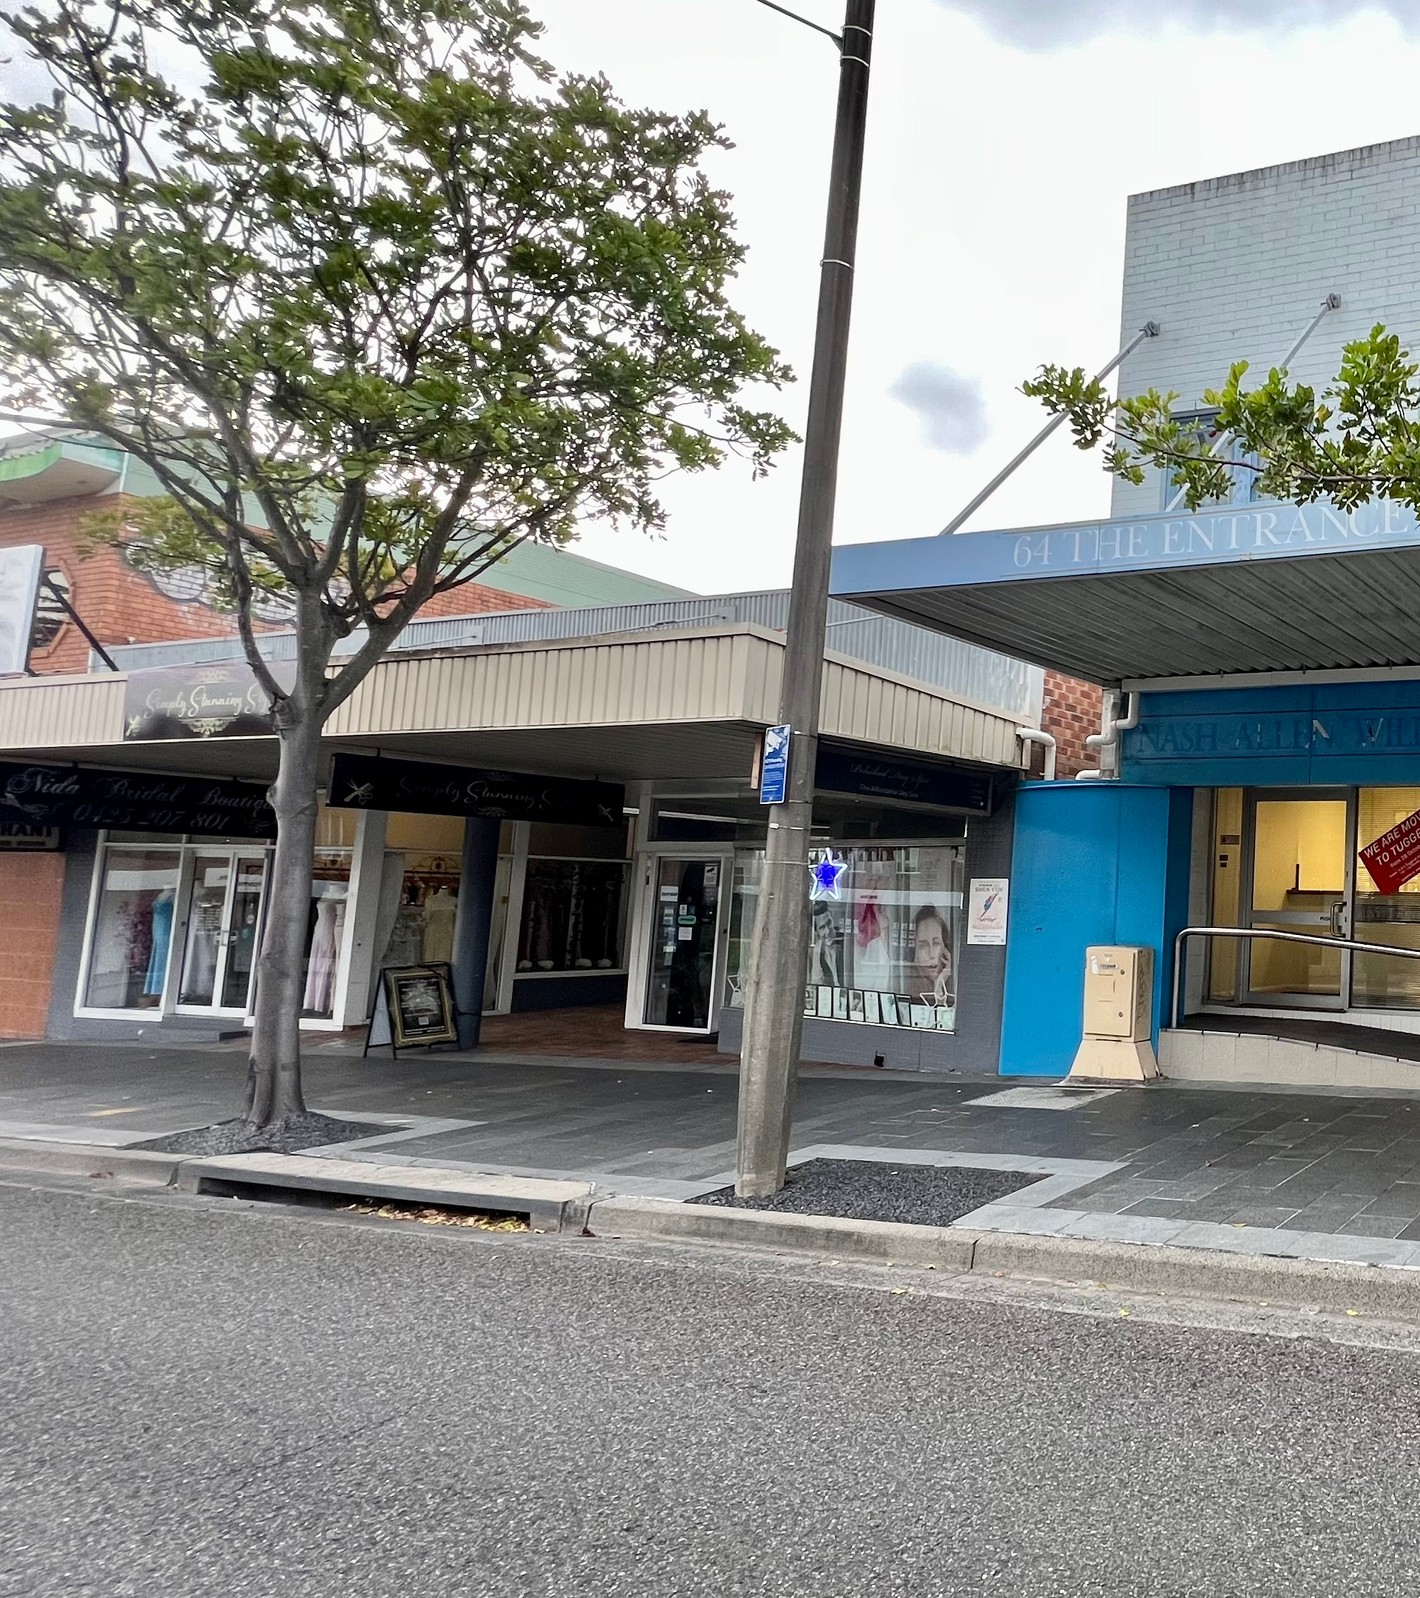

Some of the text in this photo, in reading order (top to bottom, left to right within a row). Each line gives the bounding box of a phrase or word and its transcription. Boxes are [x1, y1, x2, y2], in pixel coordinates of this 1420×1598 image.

[1013, 535, 1053, 568] 64
[1062, 524, 1150, 562] THE
[1161, 498, 1409, 556] ENTRANCE
[1136, 720, 1218, 753] NASH
[1234, 718, 1334, 751] ALLEN
[1363, 845, 1380, 858] WE
[1381, 828, 1401, 848] ARE
[1375, 851, 1390, 866] TO
